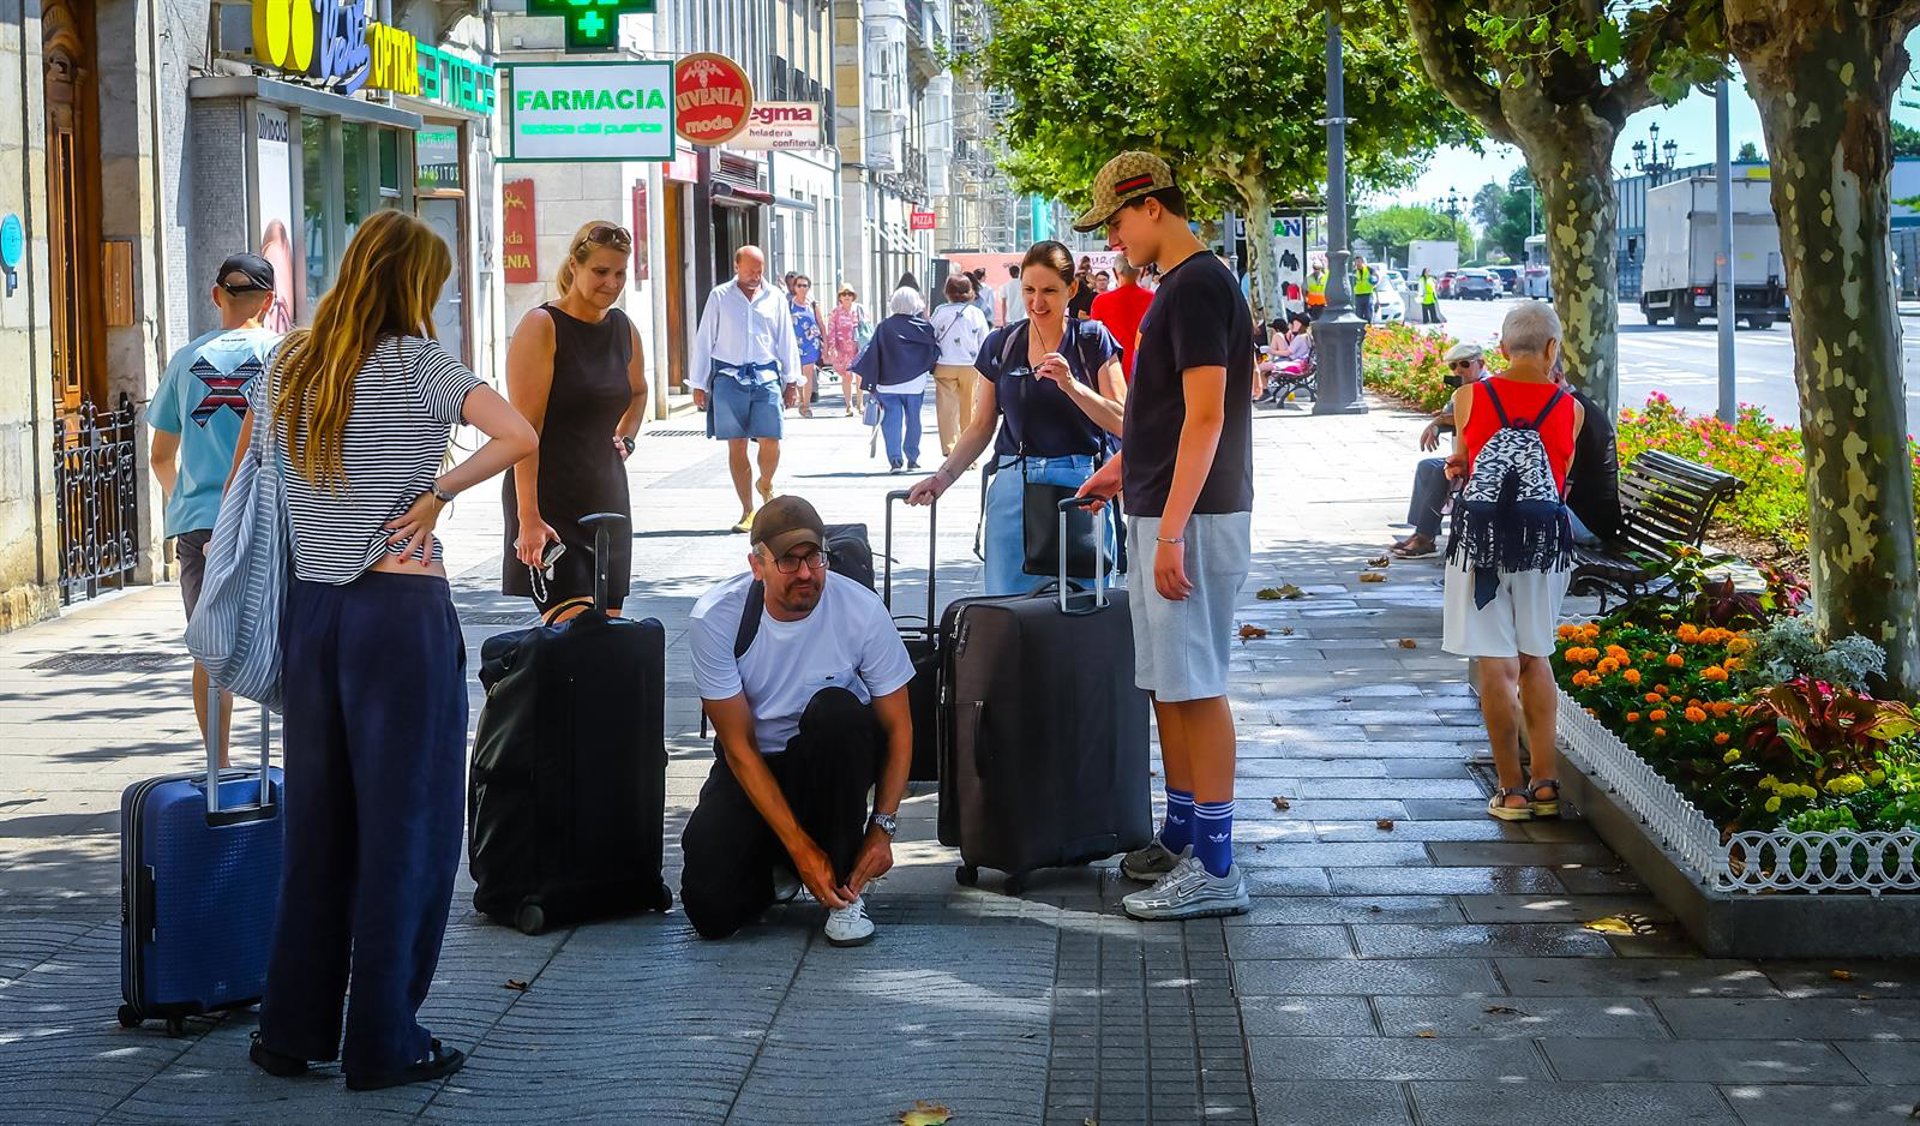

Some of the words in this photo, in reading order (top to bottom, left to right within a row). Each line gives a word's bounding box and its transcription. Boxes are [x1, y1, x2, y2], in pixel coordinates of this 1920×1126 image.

[374, 21, 420, 96] OPTICA
[516, 88, 666, 111] FARMACIA
[676, 86, 744, 117] UVENIA
[685, 114, 733, 133] moda
[749, 106, 812, 124] egma
[912, 214, 934, 226] PIZZA
